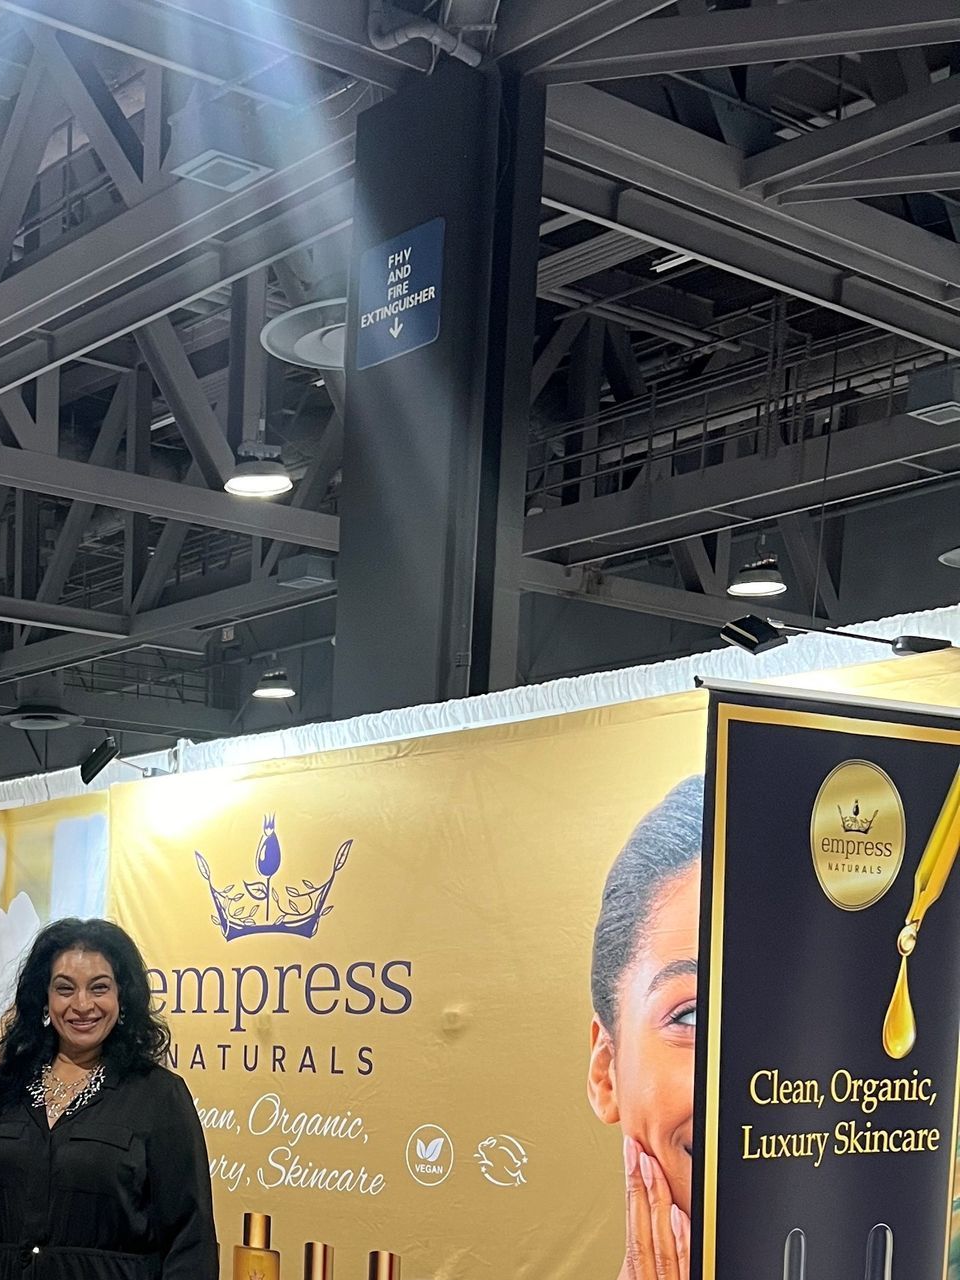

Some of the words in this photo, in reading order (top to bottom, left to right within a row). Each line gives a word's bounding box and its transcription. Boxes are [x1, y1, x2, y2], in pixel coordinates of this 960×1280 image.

[387, 264, 411, 285] AND
[387, 280, 409, 301] FIRE
[360, 286, 435, 328] EXTINGUISHER
[821, 836, 892, 859] empress
[828, 862, 882, 875] NATURALS
[144, 960, 413, 1032] empress
[749, 1069, 825, 1109] Clean,
[830, 1069, 937, 1114] Organic,
[248, 1092, 369, 1147] Organic,
[742, 1125, 829, 1167] Luxury
[834, 1121, 940, 1156] Skincare
[257, 1146, 386, 1196] Skincare
[414, 1163, 443, 1175] VEGAN
